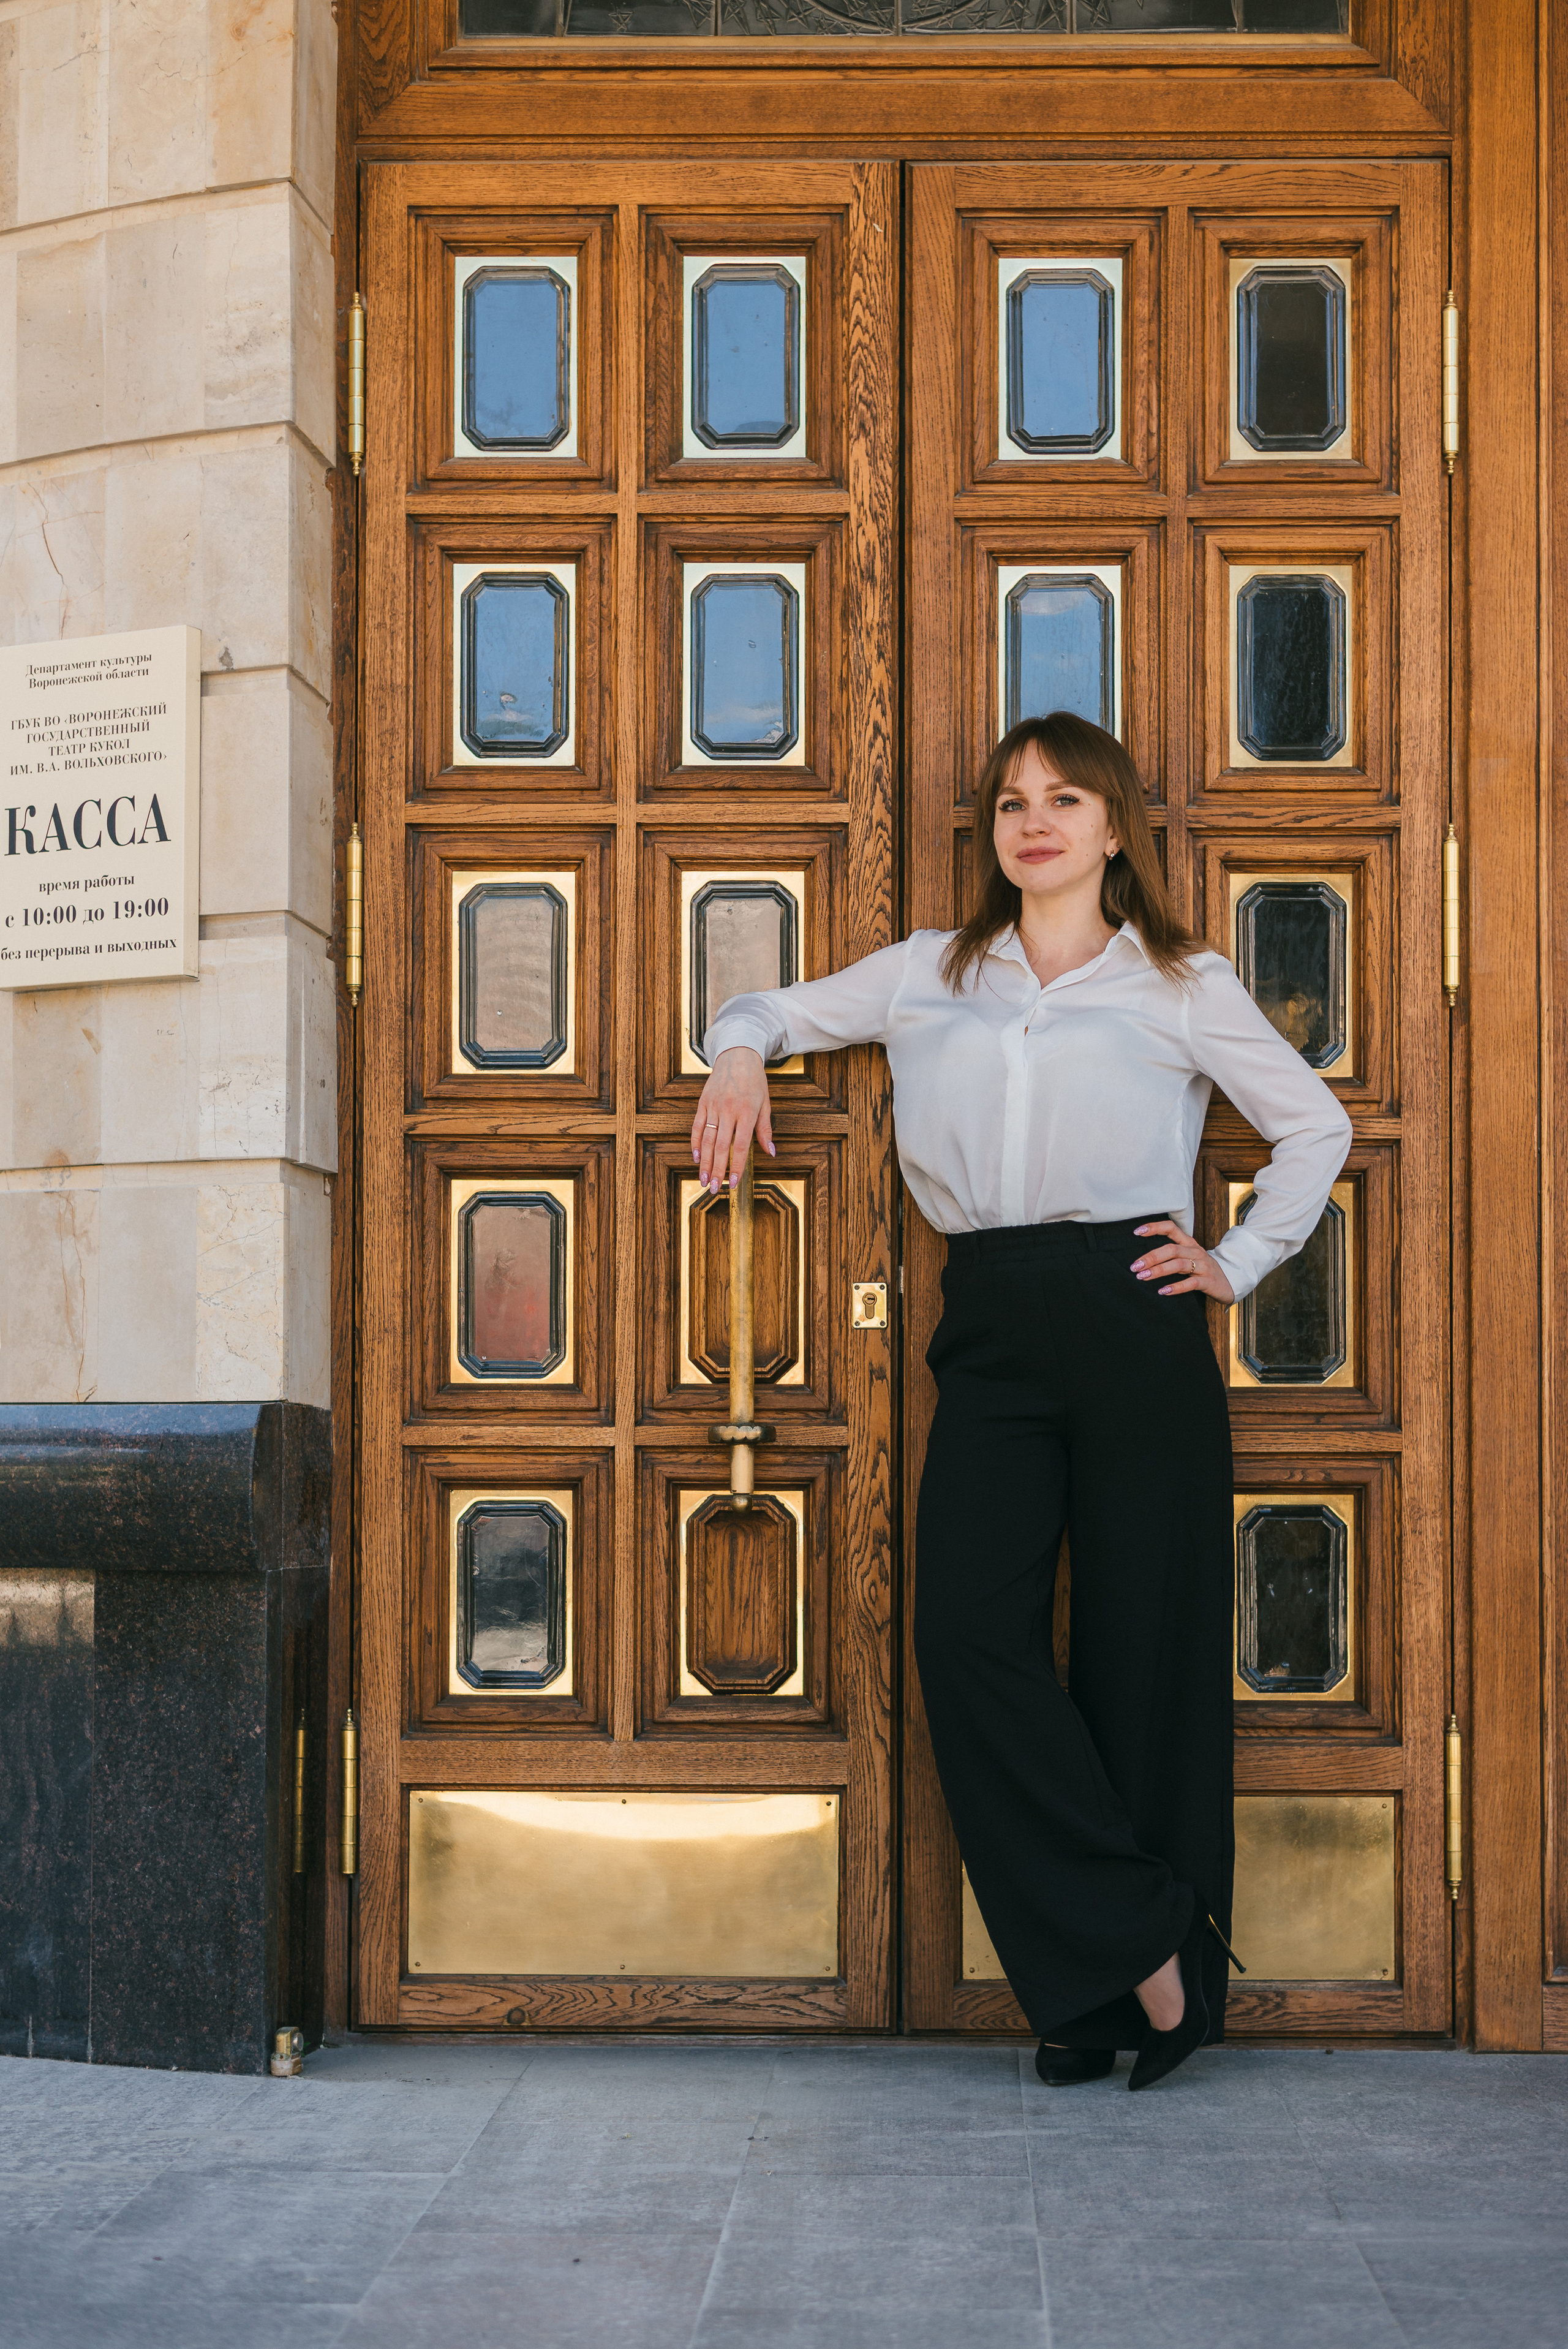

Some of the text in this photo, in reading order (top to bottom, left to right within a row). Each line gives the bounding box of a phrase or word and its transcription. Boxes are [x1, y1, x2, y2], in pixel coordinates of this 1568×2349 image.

[25, 654, 152, 676] Департамент культуры
[29, 668, 149, 690] Воронежской области
[11, 716, 40, 730] ГБУК
[44, 716, 61, 727] ВО
[26, 719, 150, 744] ГОСУДАРСТВЕННЫЙ
[48, 739, 129, 756] ТЕАТР КУКОЛ
[10, 765, 32, 776] ИМ.
[37, 762, 60, 773] В.А.
[4, 793, 172, 856] КАССА
[39, 875, 134, 895] время работы
[6, 898, 168, 928] с 10:00 до 19:00
[1, 939, 176, 961] без перерыва и выходных
